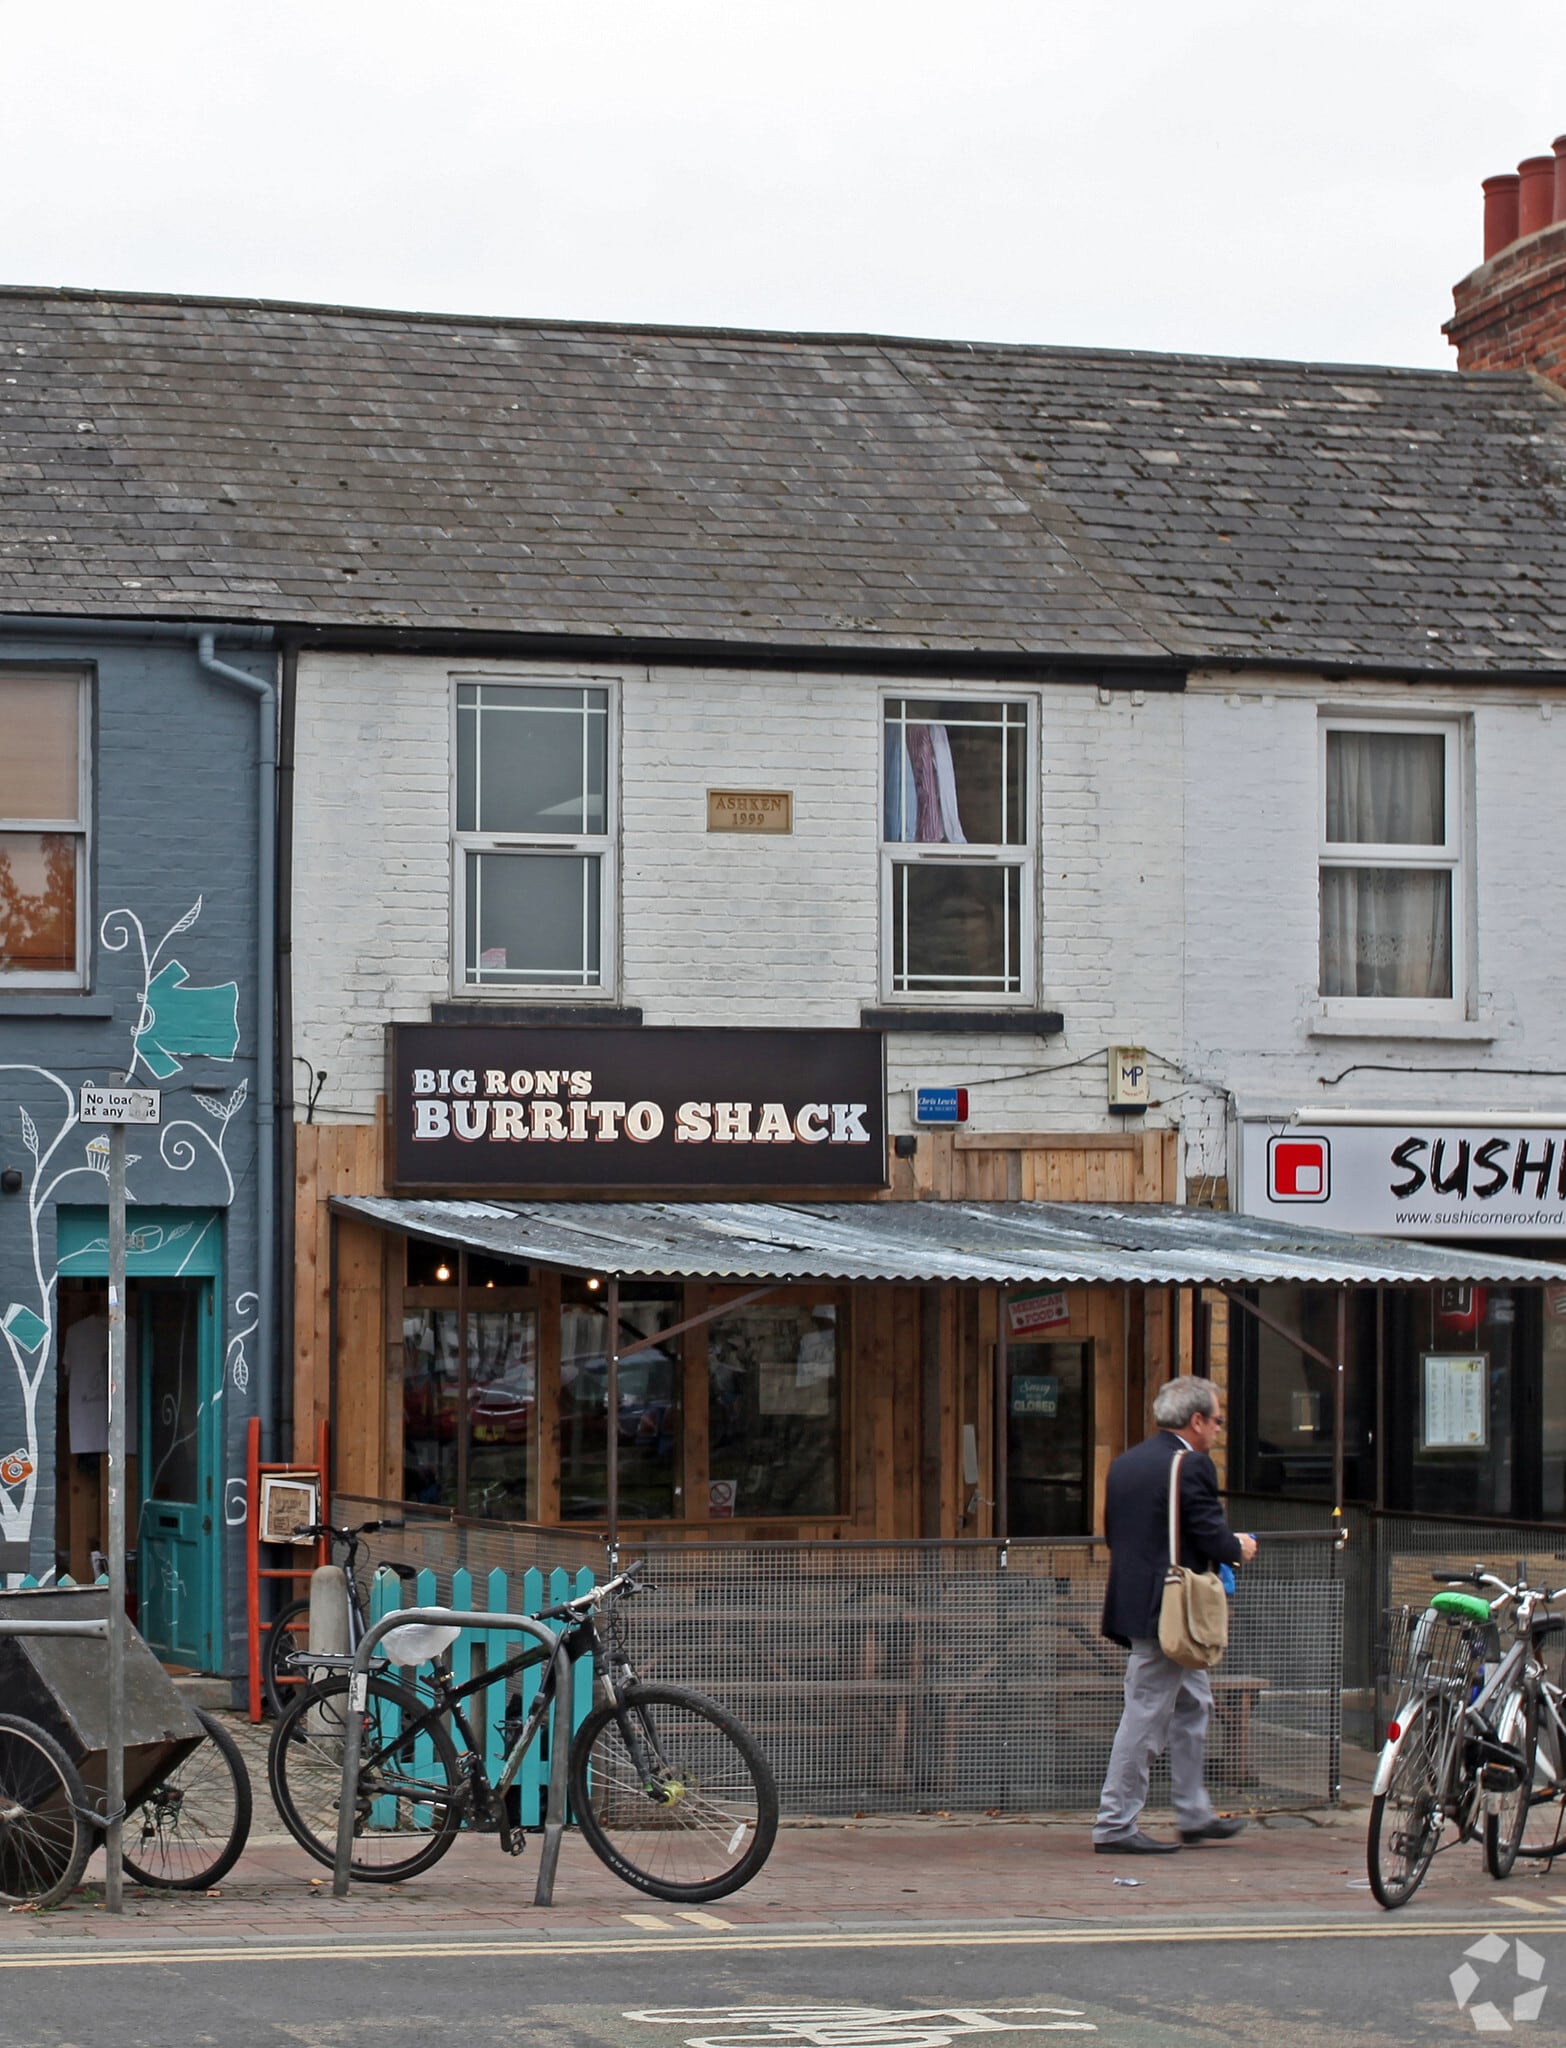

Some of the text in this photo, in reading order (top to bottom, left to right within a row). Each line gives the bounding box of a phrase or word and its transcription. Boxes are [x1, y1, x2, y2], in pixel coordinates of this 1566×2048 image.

[716, 797, 781, 812] ASHKEN
[731, 812, 765, 825] 1999
[412, 1069, 593, 1098] BIG RON'S
[1122, 1066, 1144, 1087] MP
[87, 1094, 154, 1107] No loag
[84, 1106, 97, 1116] at
[103, 1108, 124, 1118] any
[412, 1100, 871, 1144] BURRITO SHACK
[1025, 1309, 1054, 1324] FOOD
[1014, 1399, 1056, 1413] CLOSED
